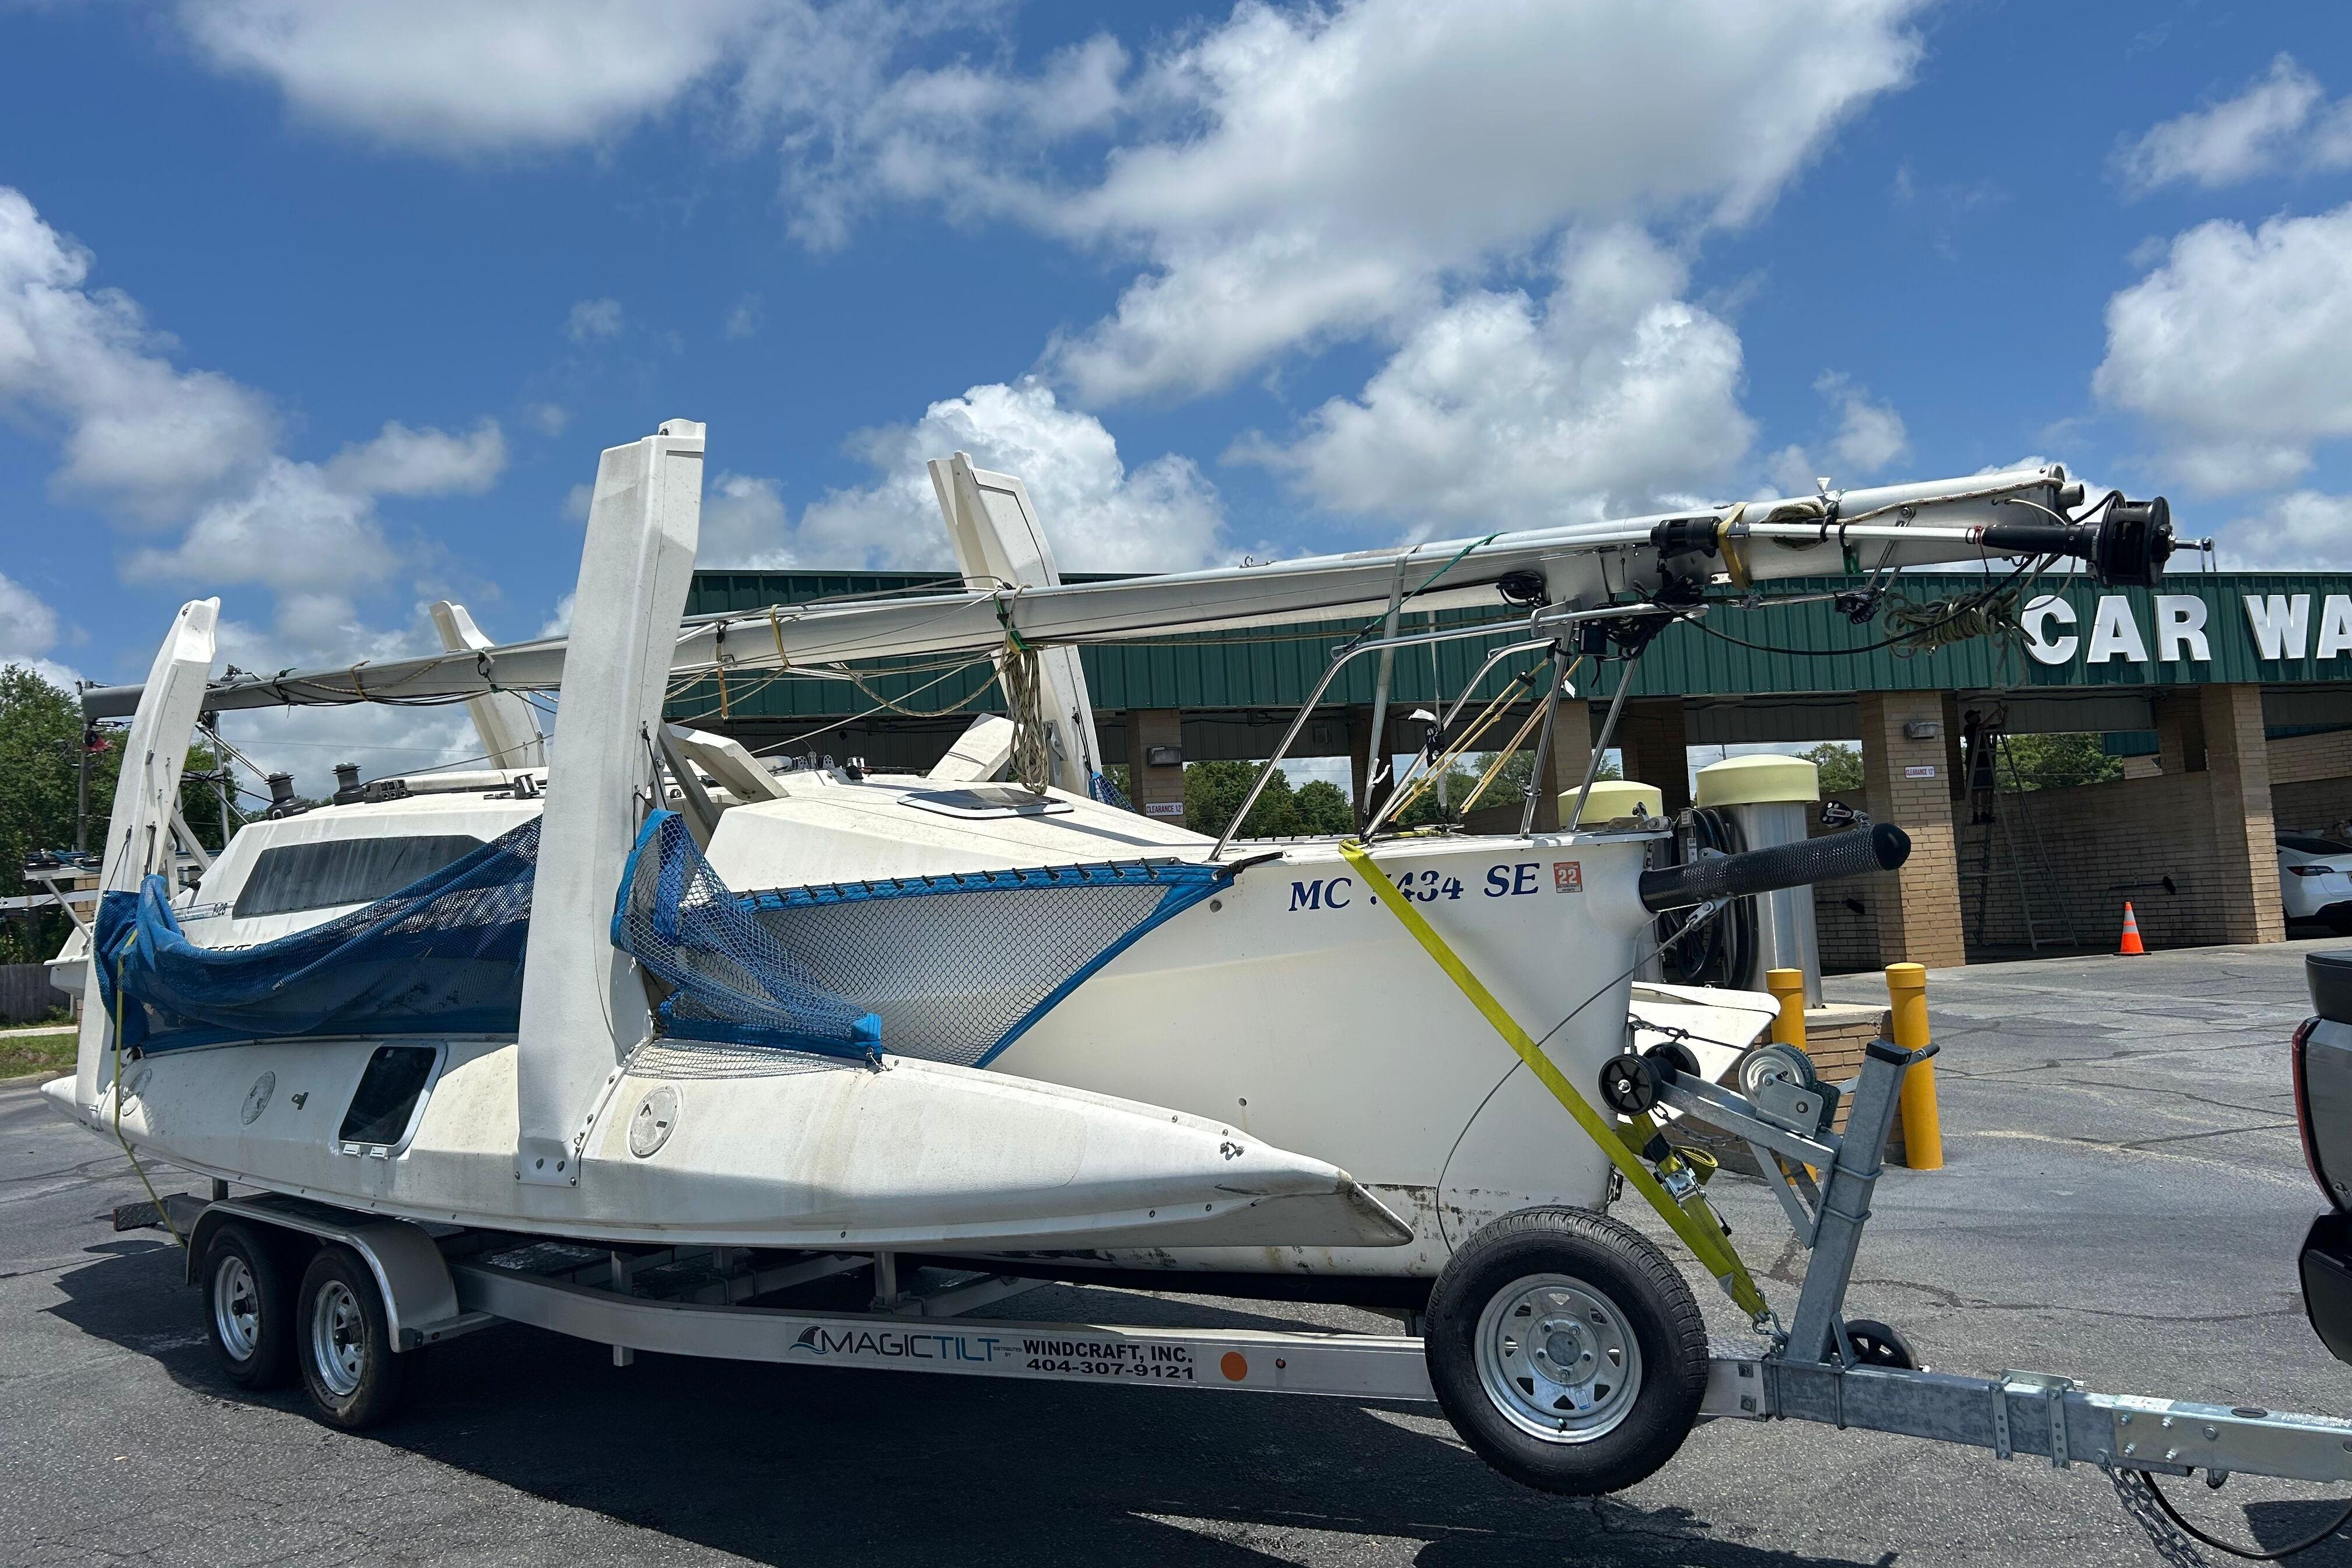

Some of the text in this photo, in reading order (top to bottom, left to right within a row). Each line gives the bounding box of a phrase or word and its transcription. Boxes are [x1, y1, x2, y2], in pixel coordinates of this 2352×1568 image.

[2021, 594, 2352, 665] CAR WA
[1288, 863, 1540, 911] MC 434 SE
[1558, 869, 1577, 884] 22
[821, 1329, 1000, 1362] MAGICTILT
[1023, 1339, 1193, 1364] WINDCRAFT, INC.
[1026, 1358, 1194, 1380] 404-307-9121
